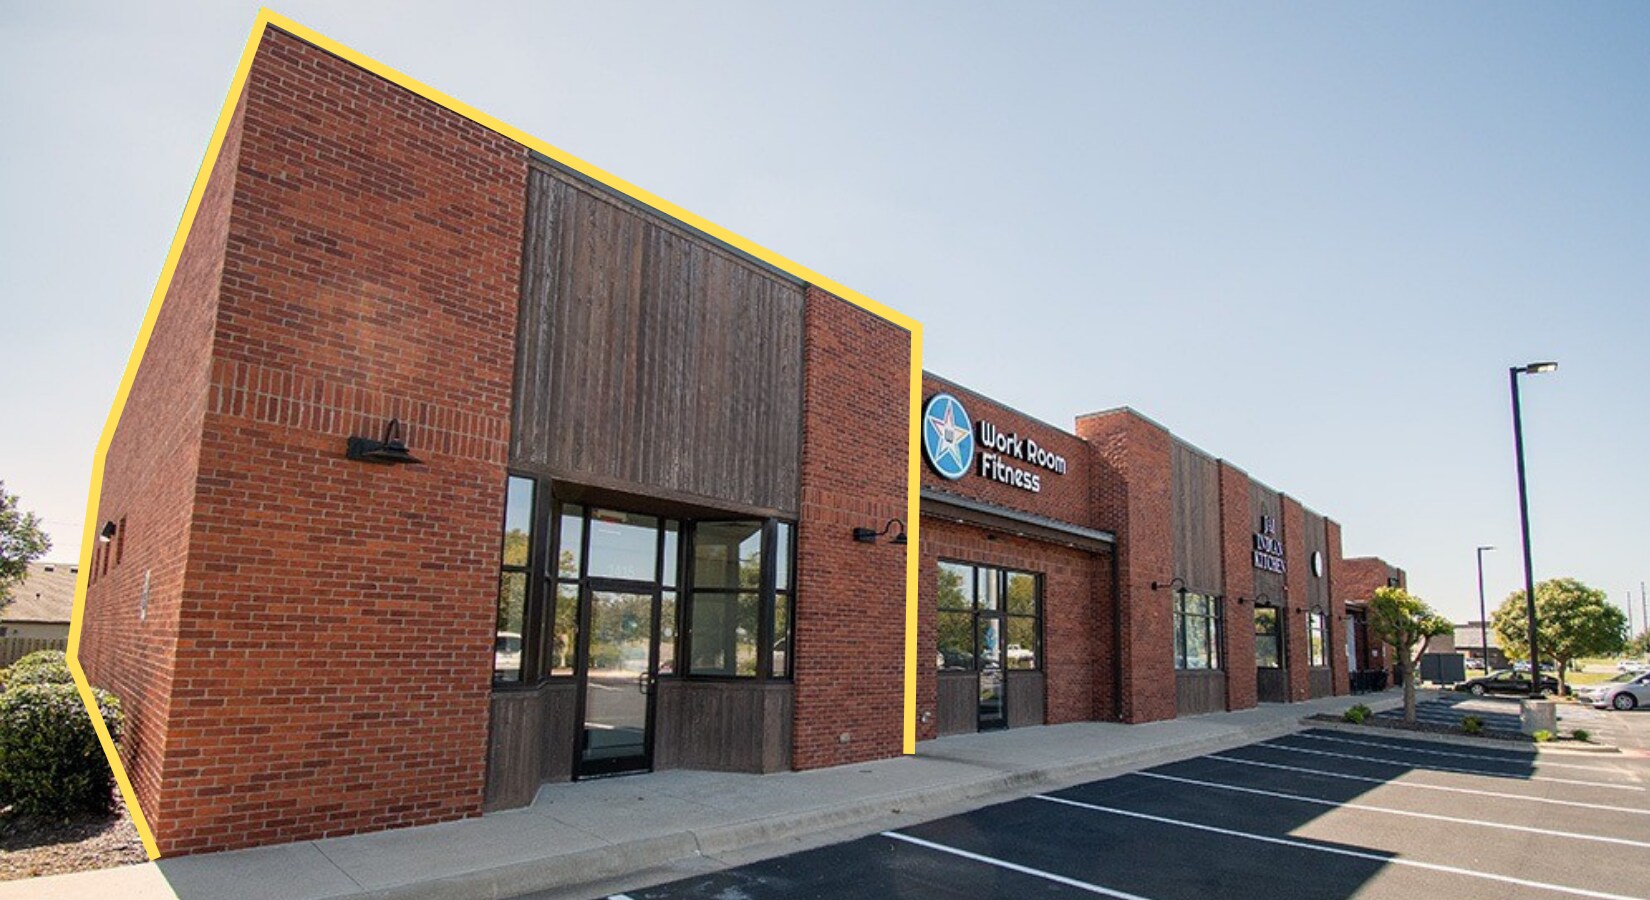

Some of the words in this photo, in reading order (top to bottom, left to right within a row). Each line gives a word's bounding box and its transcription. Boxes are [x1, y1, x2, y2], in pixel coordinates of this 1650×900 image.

[982, 420, 1023, 460] Work
[1027, 439, 1066, 474] Room
[981, 452, 1041, 492] Fitness
[1254, 551, 1286, 574] KITCHEN
